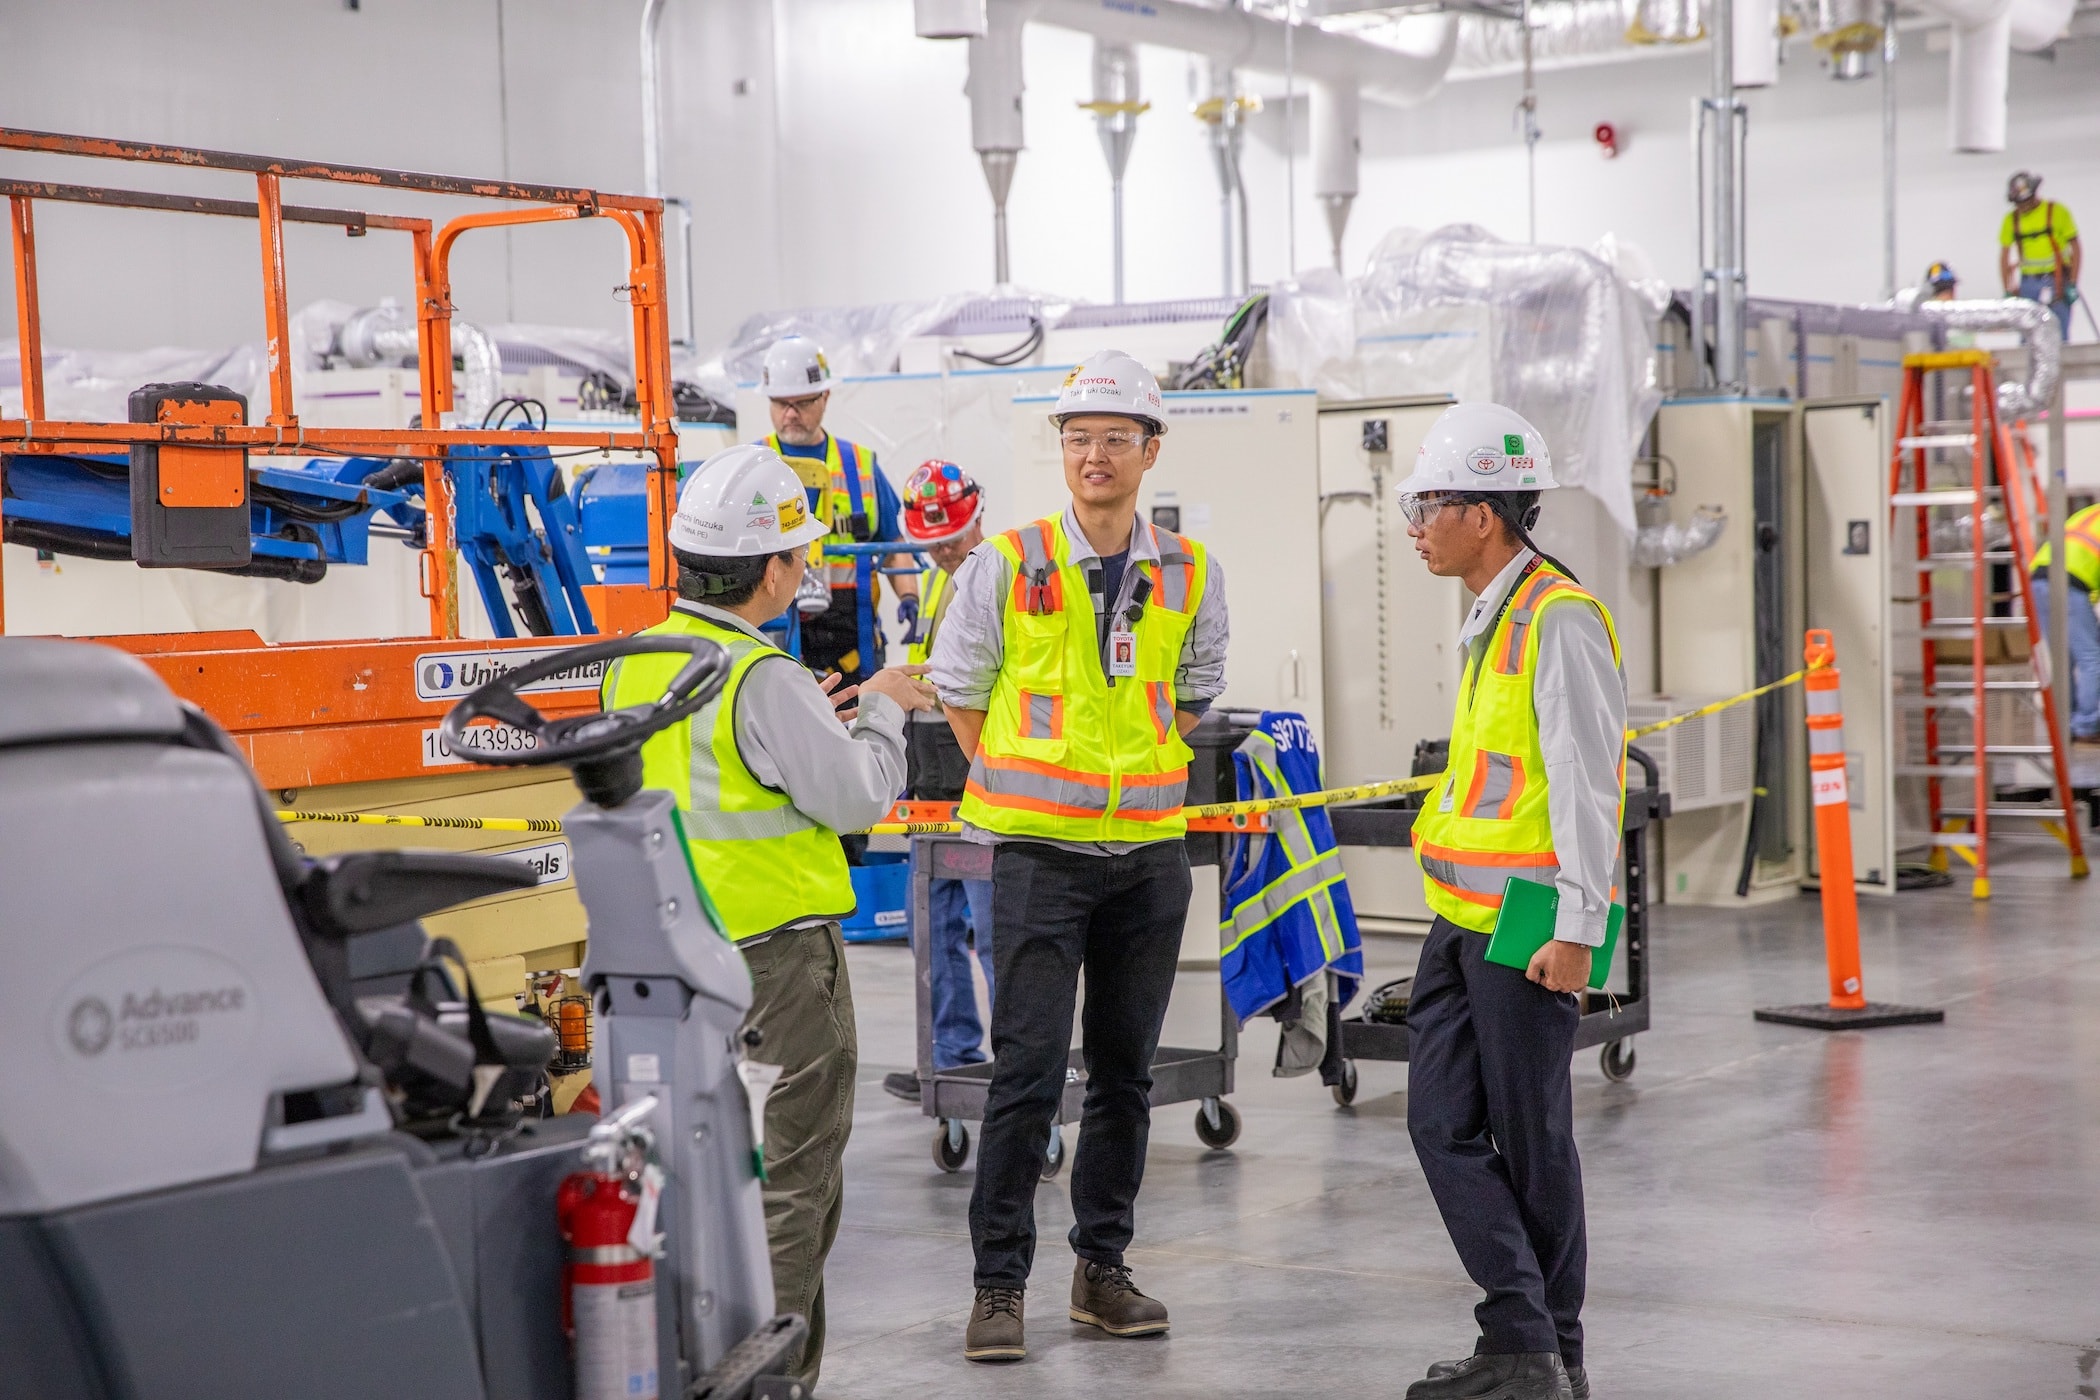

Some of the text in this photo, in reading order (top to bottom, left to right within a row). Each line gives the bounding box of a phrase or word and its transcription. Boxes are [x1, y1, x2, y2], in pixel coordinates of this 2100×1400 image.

[1079, 377, 1116, 386] TOYOTA
[1070, 387, 1122, 397] Takuki Ozaki
[693, 516, 724, 532] Inuzuka
